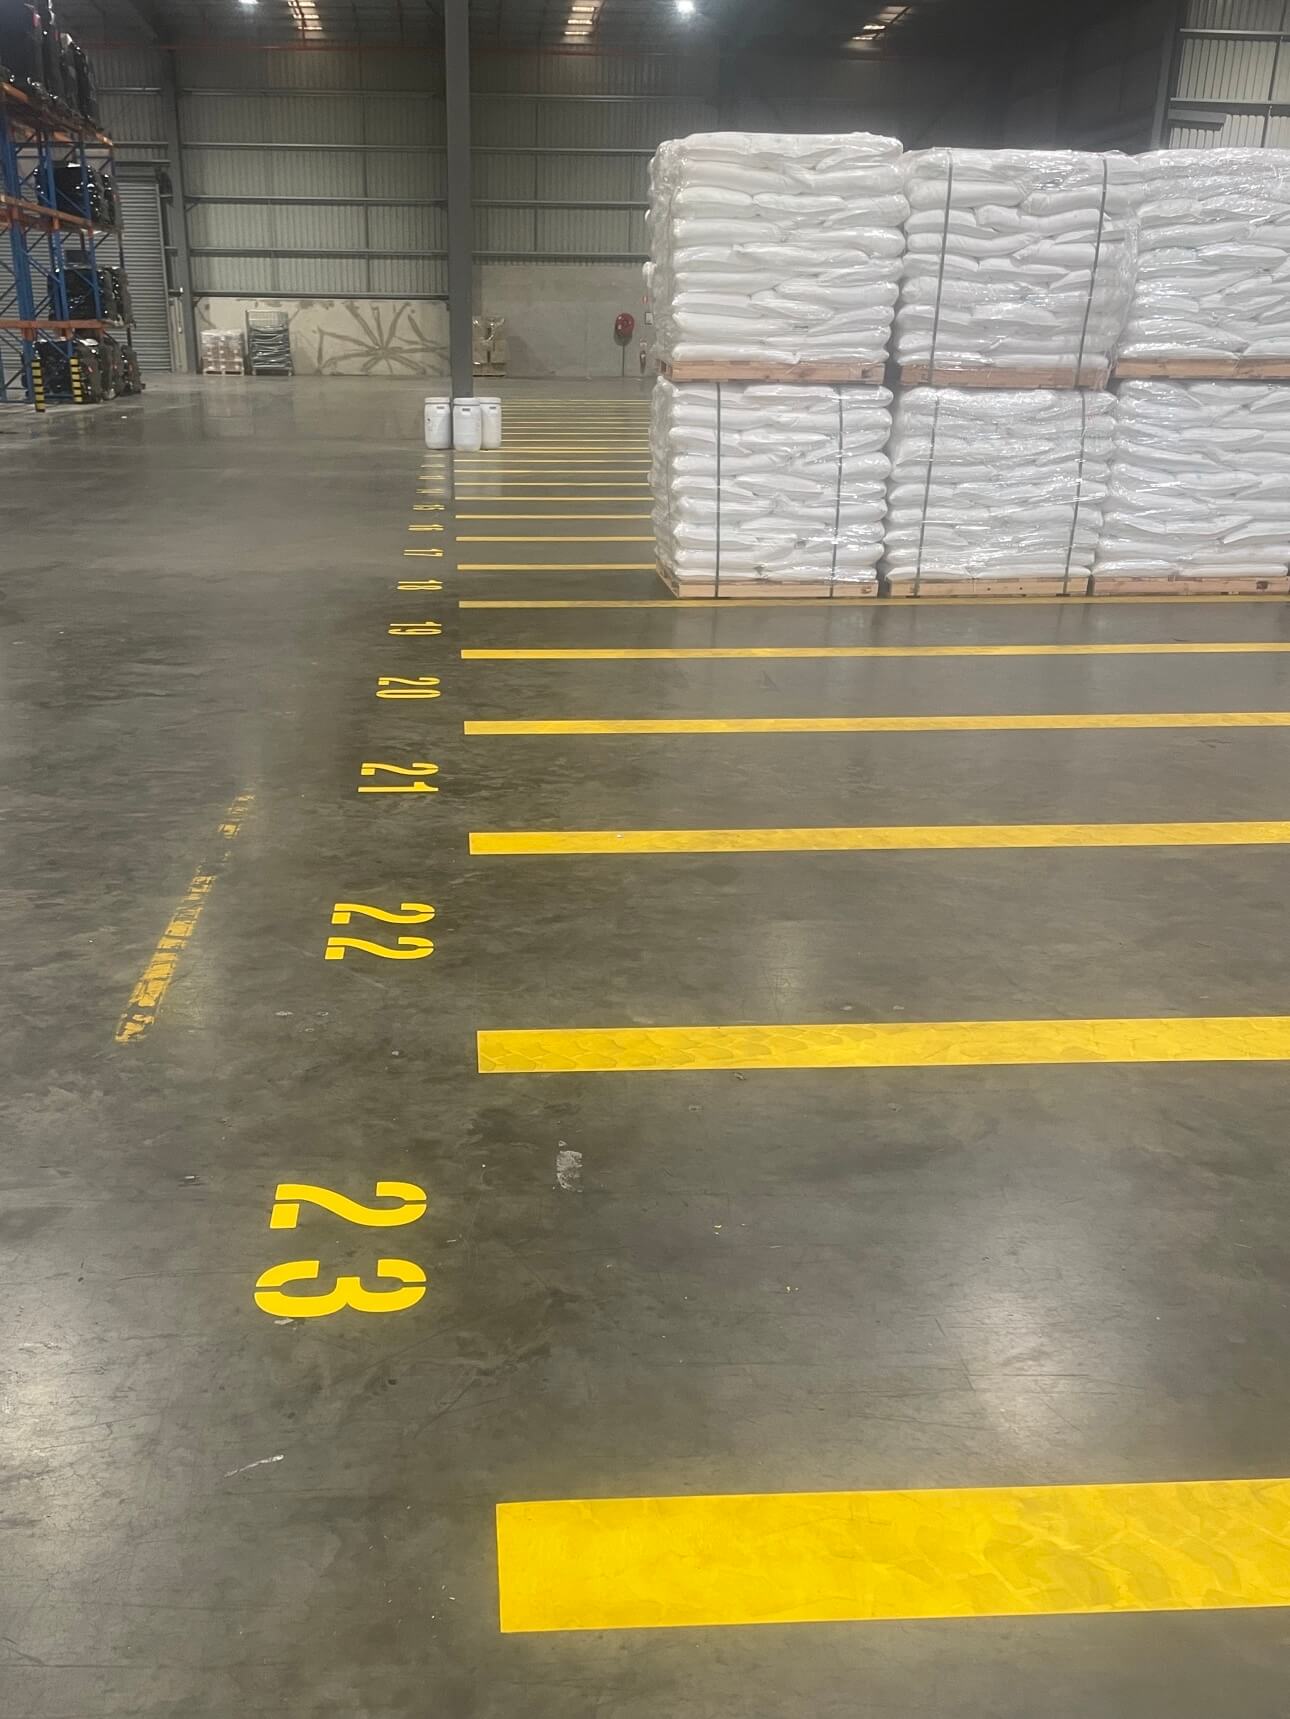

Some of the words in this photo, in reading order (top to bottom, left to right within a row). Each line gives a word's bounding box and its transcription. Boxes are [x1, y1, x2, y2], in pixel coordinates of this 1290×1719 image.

[403, 548, 443, 557] 17
[397, 580, 443, 591] 18
[388, 621, 442, 635] 19
[376, 677, 441, 699] 20
[358, 762, 440, 793] 21
[324, 903, 436, 960] 22
[254, 1181, 428, 1318] 23
